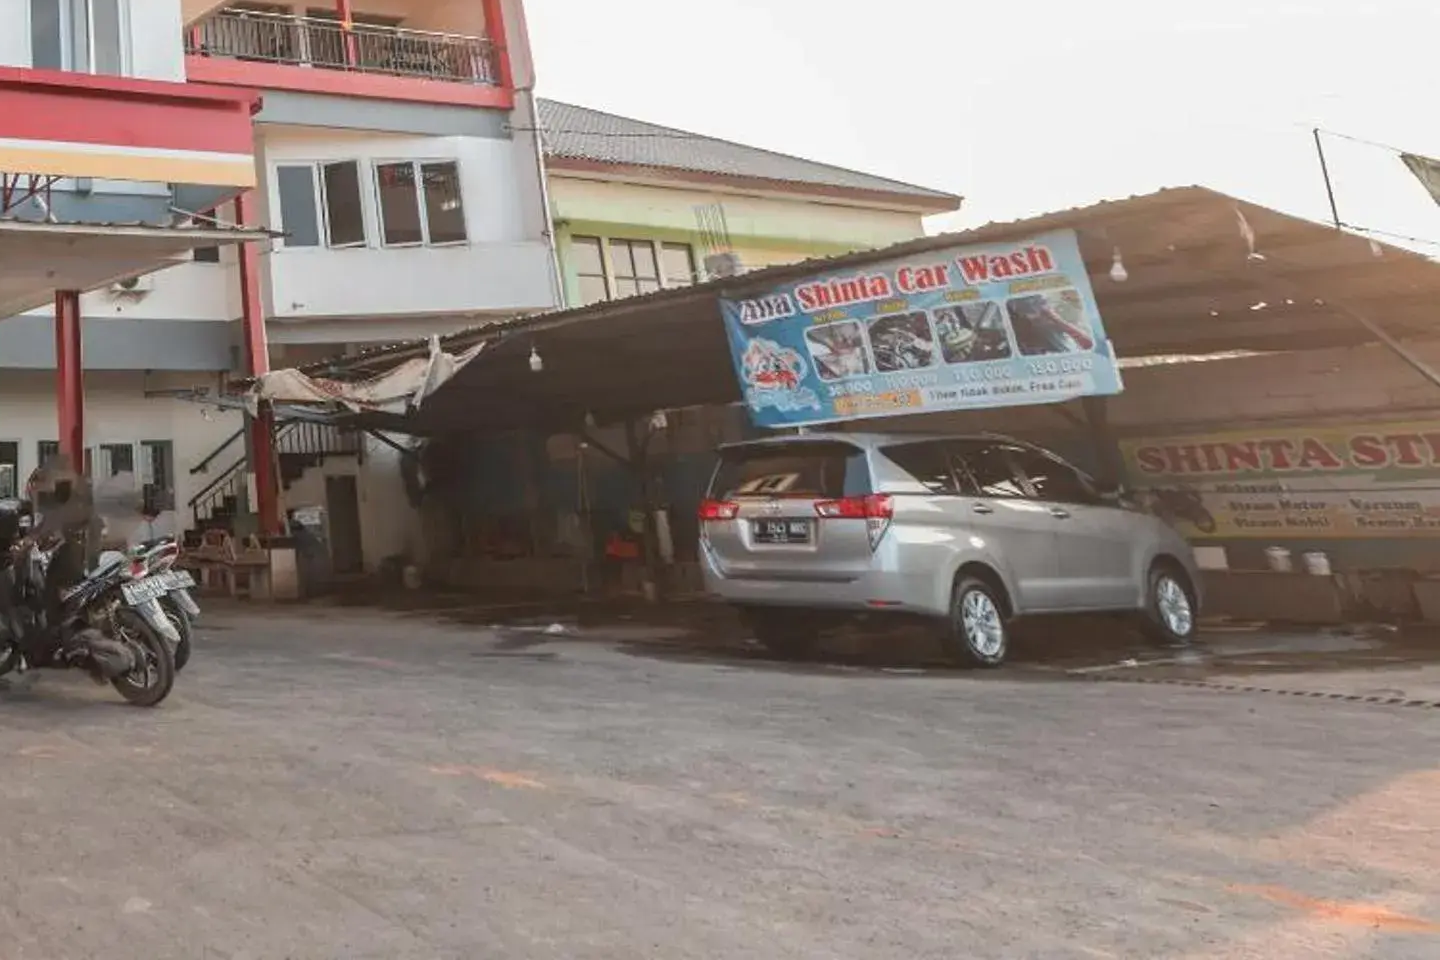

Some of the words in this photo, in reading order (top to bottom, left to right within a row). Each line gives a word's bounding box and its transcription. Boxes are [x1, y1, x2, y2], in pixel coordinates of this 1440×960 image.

[796, 275, 890, 311] Shinta
[898, 263, 950, 293] Car
[957, 244, 1055, 284] Wash
[1138, 438, 1340, 473] SHINTA
